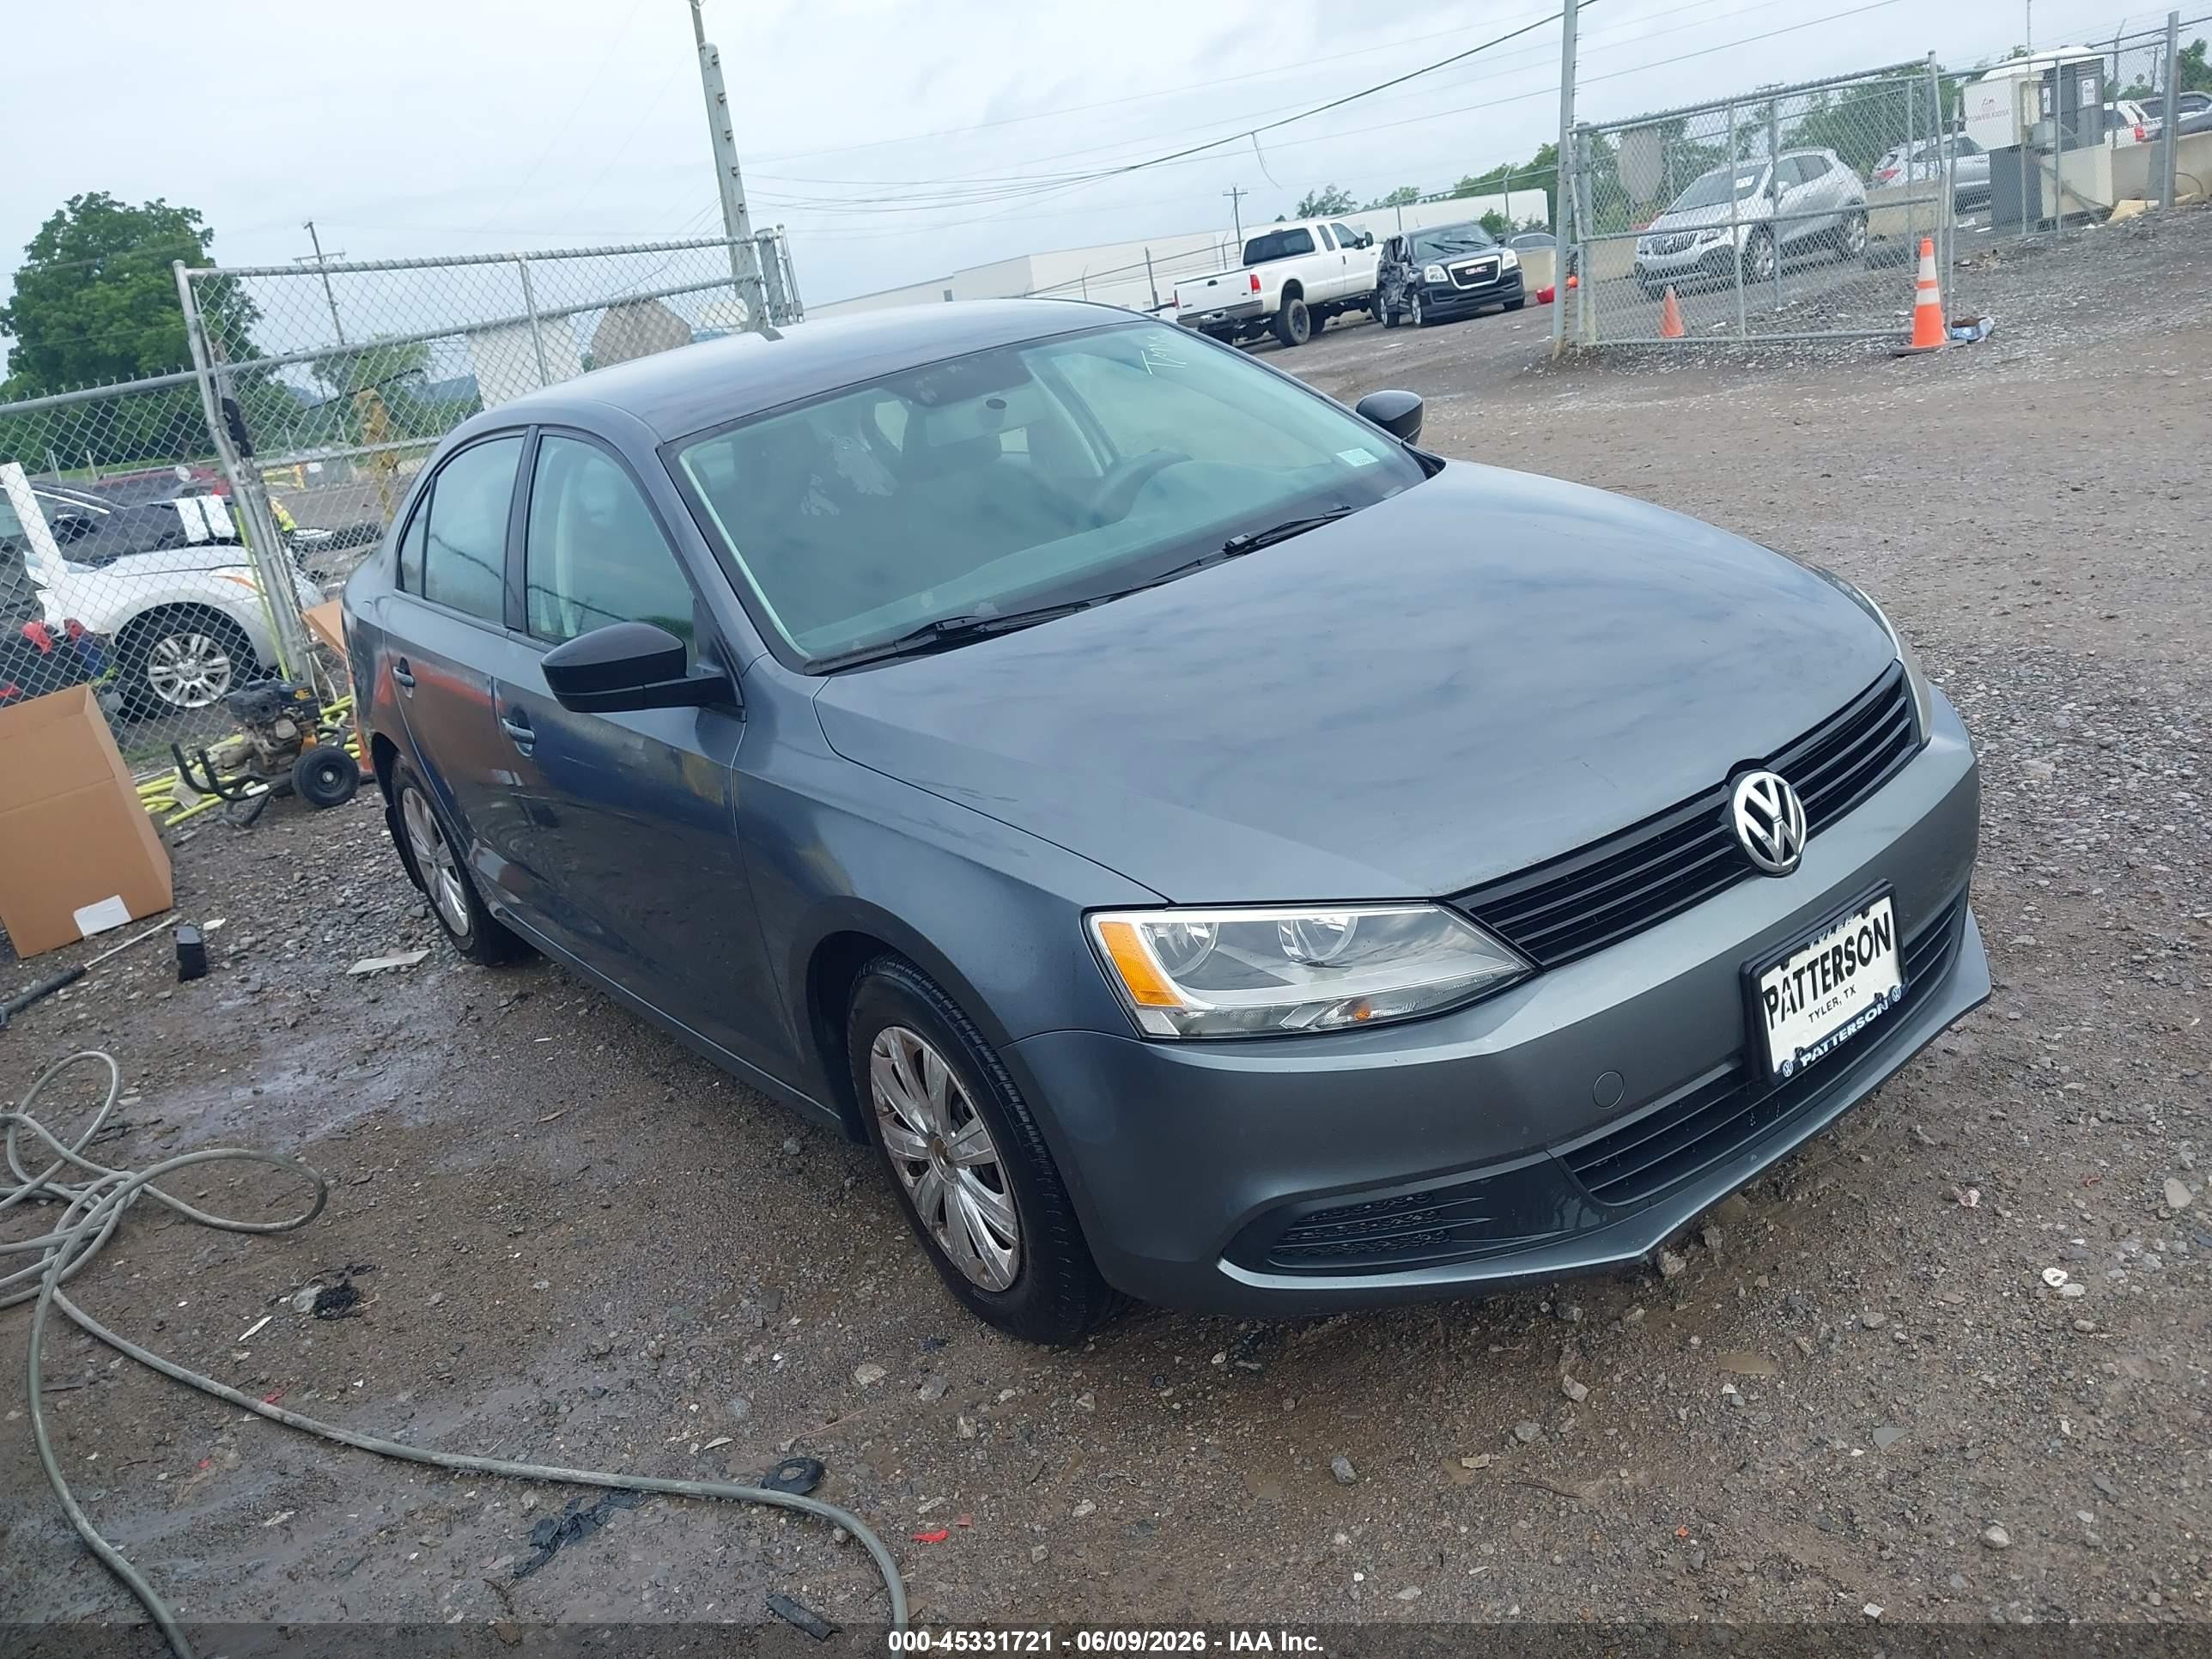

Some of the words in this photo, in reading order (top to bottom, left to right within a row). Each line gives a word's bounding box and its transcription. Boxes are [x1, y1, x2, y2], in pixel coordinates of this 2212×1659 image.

[1465, 265, 1487, 275] GMC
[1762, 912, 1891, 1030] PATTERSON
[1808, 996, 1843, 1024] TYLER,
[1844, 984, 1856, 999] TX
[1800, 1000, 1890, 1066] PATTERSON
